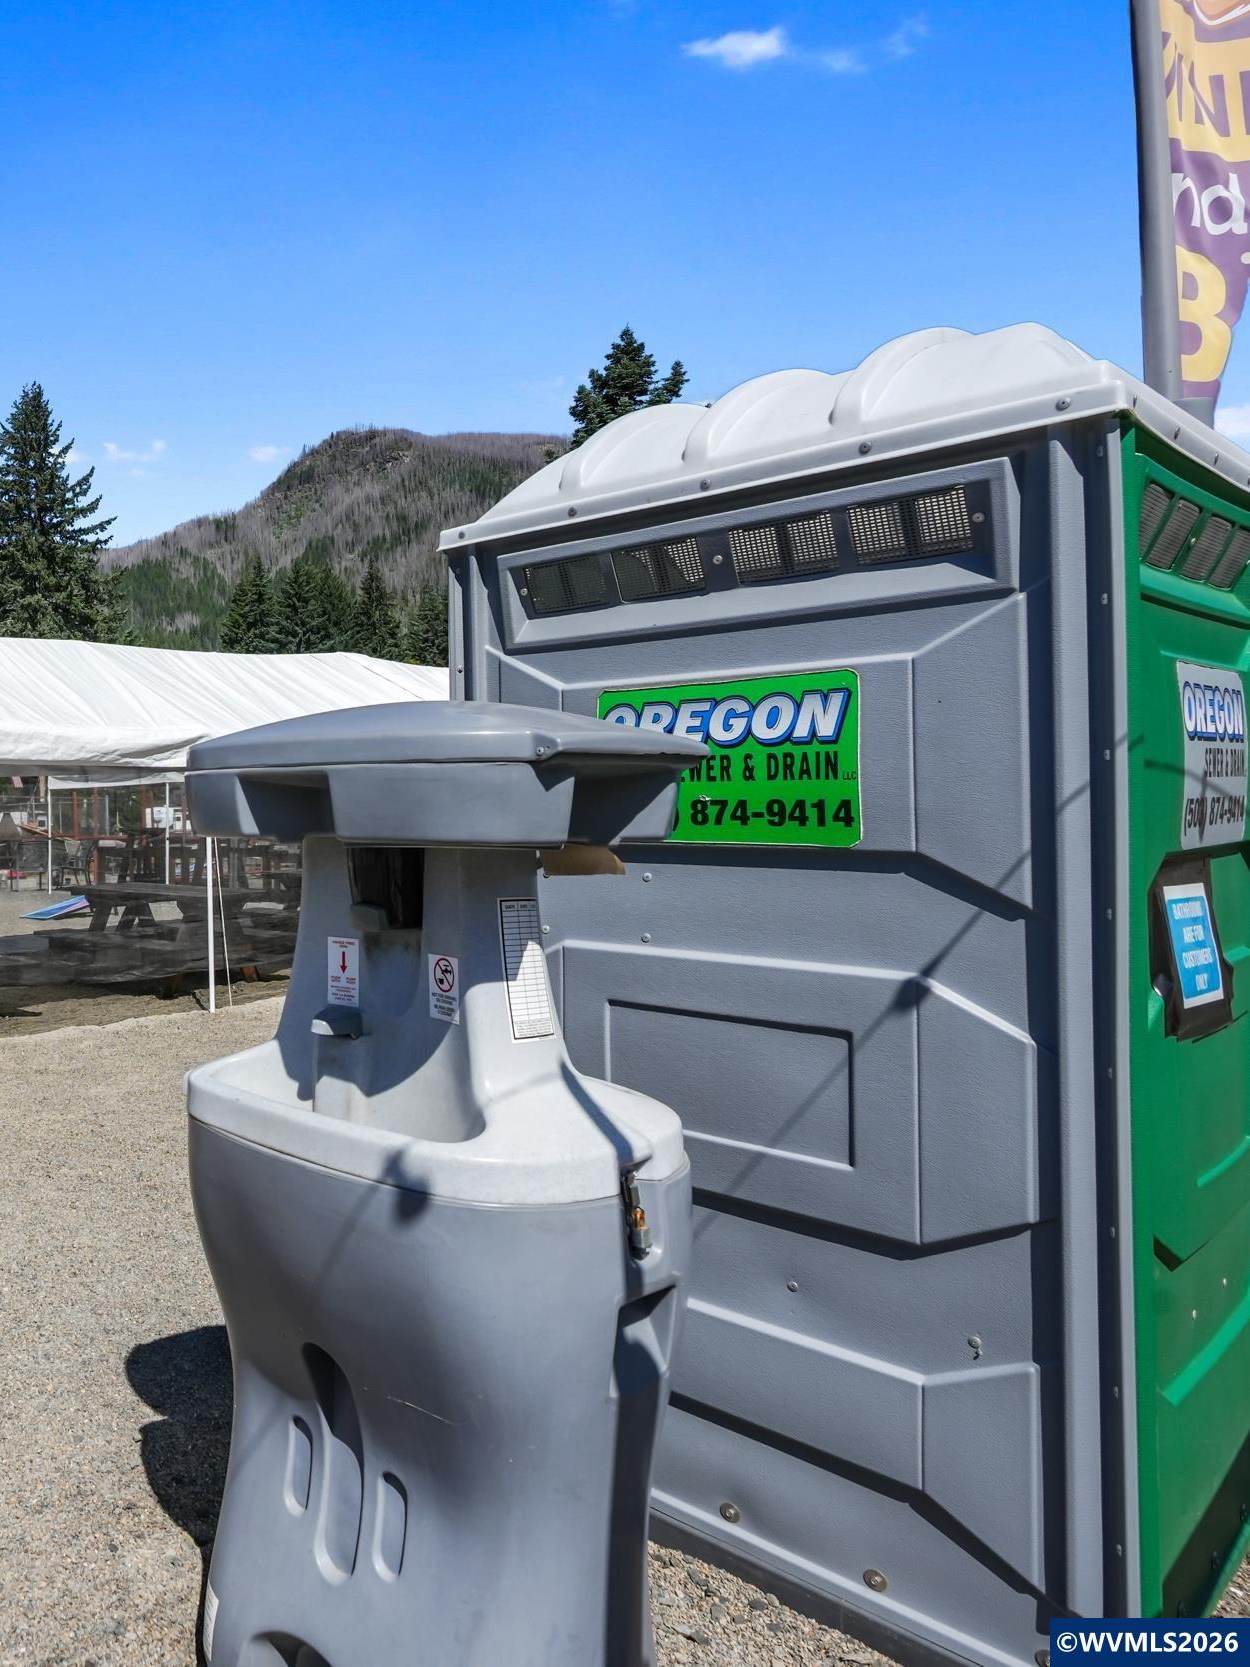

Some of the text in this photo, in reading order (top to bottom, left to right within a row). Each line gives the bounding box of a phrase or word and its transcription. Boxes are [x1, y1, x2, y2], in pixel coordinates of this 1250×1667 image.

[1171, 172, 1248, 235] nd
[1182, 680, 1244, 743] OREGON
[680, 751, 857, 782] WER & DRAIN LLC
[1205, 747, 1224, 778] SEWER
[689, 798, 855, 828] 874-9414
[1209, 794, 1245, 826] 874-9414
